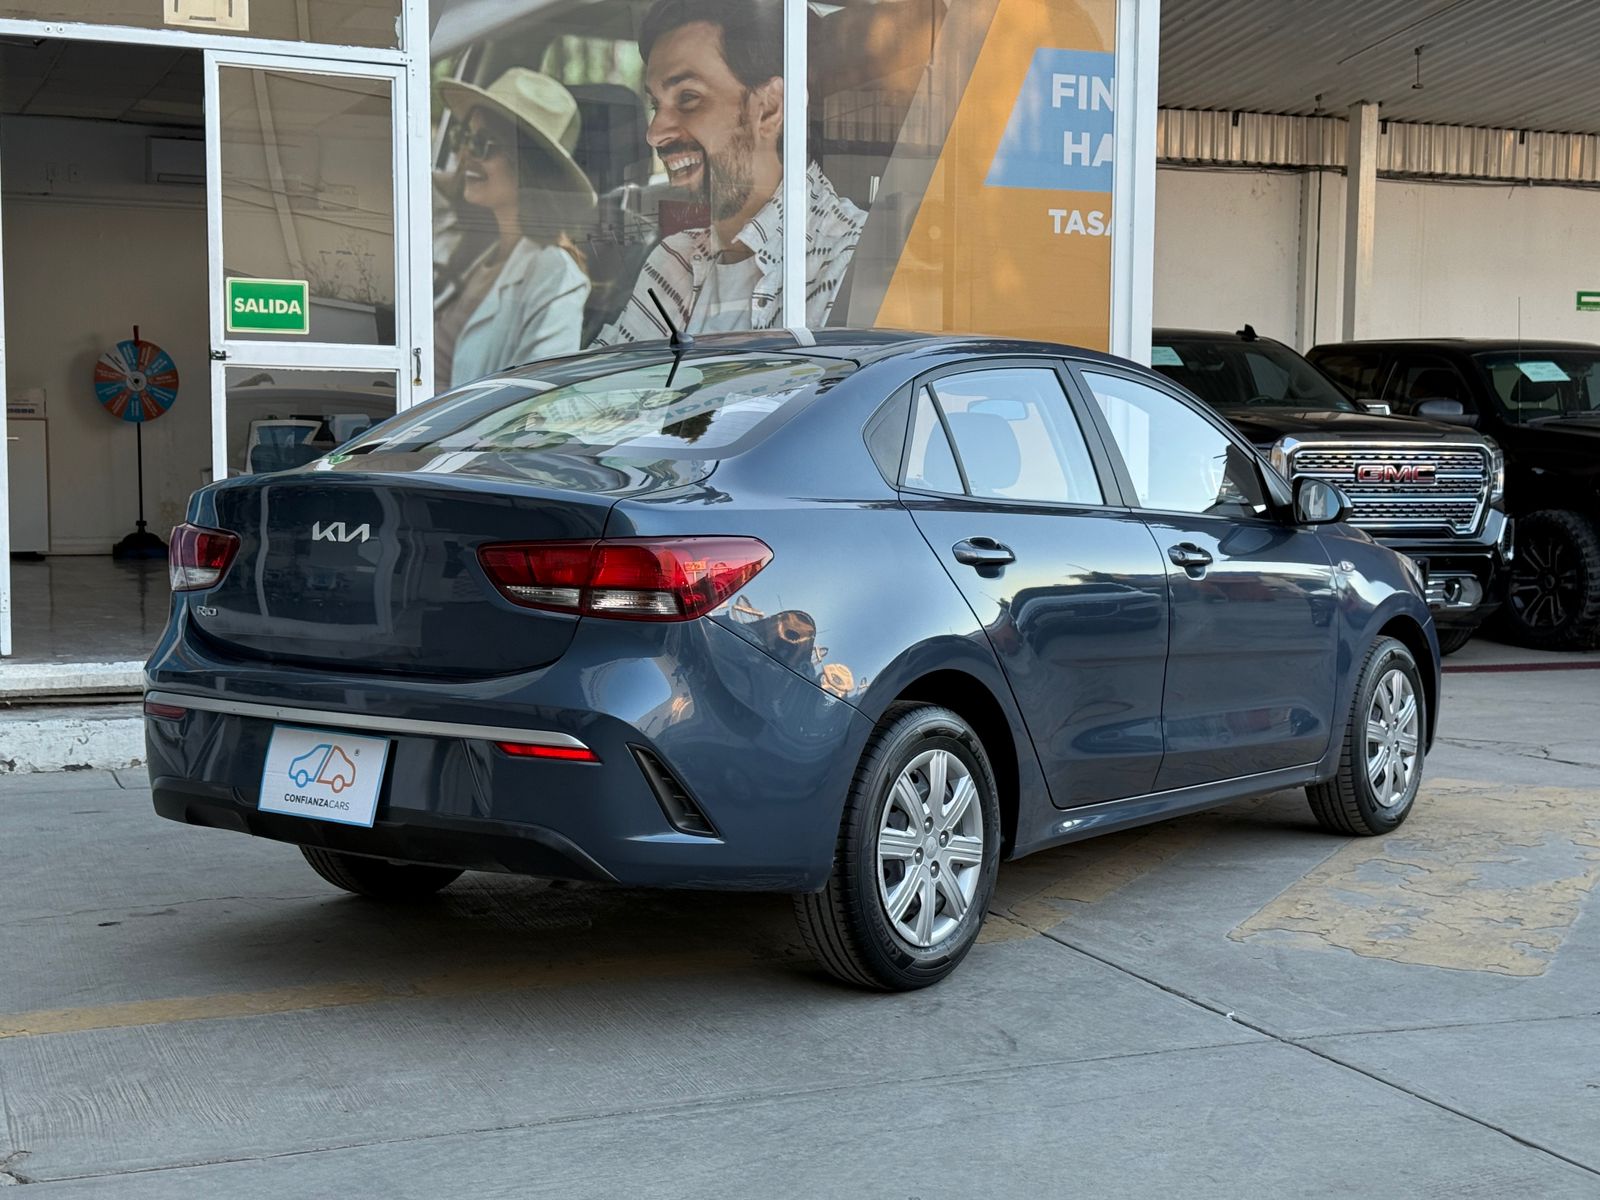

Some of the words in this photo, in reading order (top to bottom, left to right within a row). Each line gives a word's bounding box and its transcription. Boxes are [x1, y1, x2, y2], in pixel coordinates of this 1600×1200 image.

[1052, 73, 1114, 111] FIN
[234, 297, 302, 315] SALIDA
[1358, 465, 1436, 483] GMC
[312, 521, 370, 543] KIA
